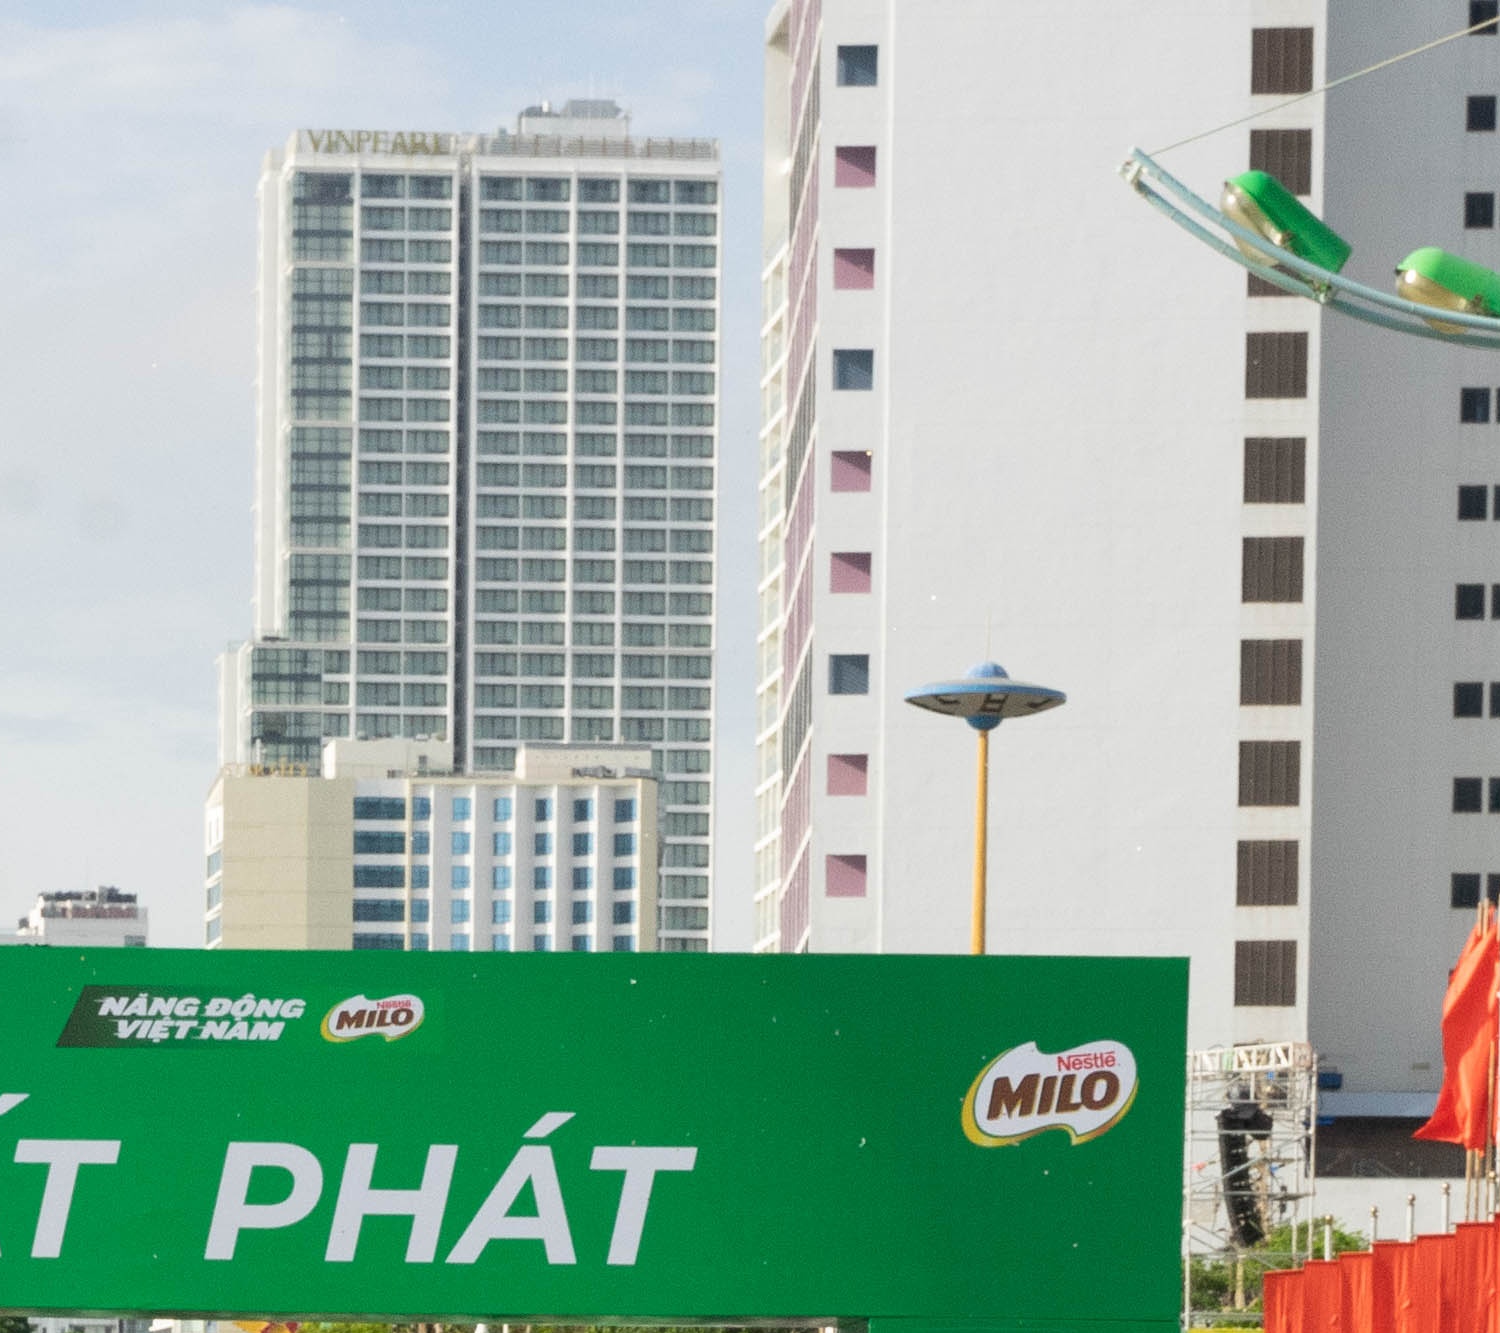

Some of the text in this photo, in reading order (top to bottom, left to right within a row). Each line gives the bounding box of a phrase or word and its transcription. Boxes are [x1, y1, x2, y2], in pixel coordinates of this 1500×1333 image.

[96, 993, 306, 1019] NĂNG ĐỘNG
[336, 1008, 413, 1030] MILO
[199, 1021, 285, 1041] NAM
[986, 1070, 1120, 1121] MILO
[204, 1110, 696, 1267] PHÁT
